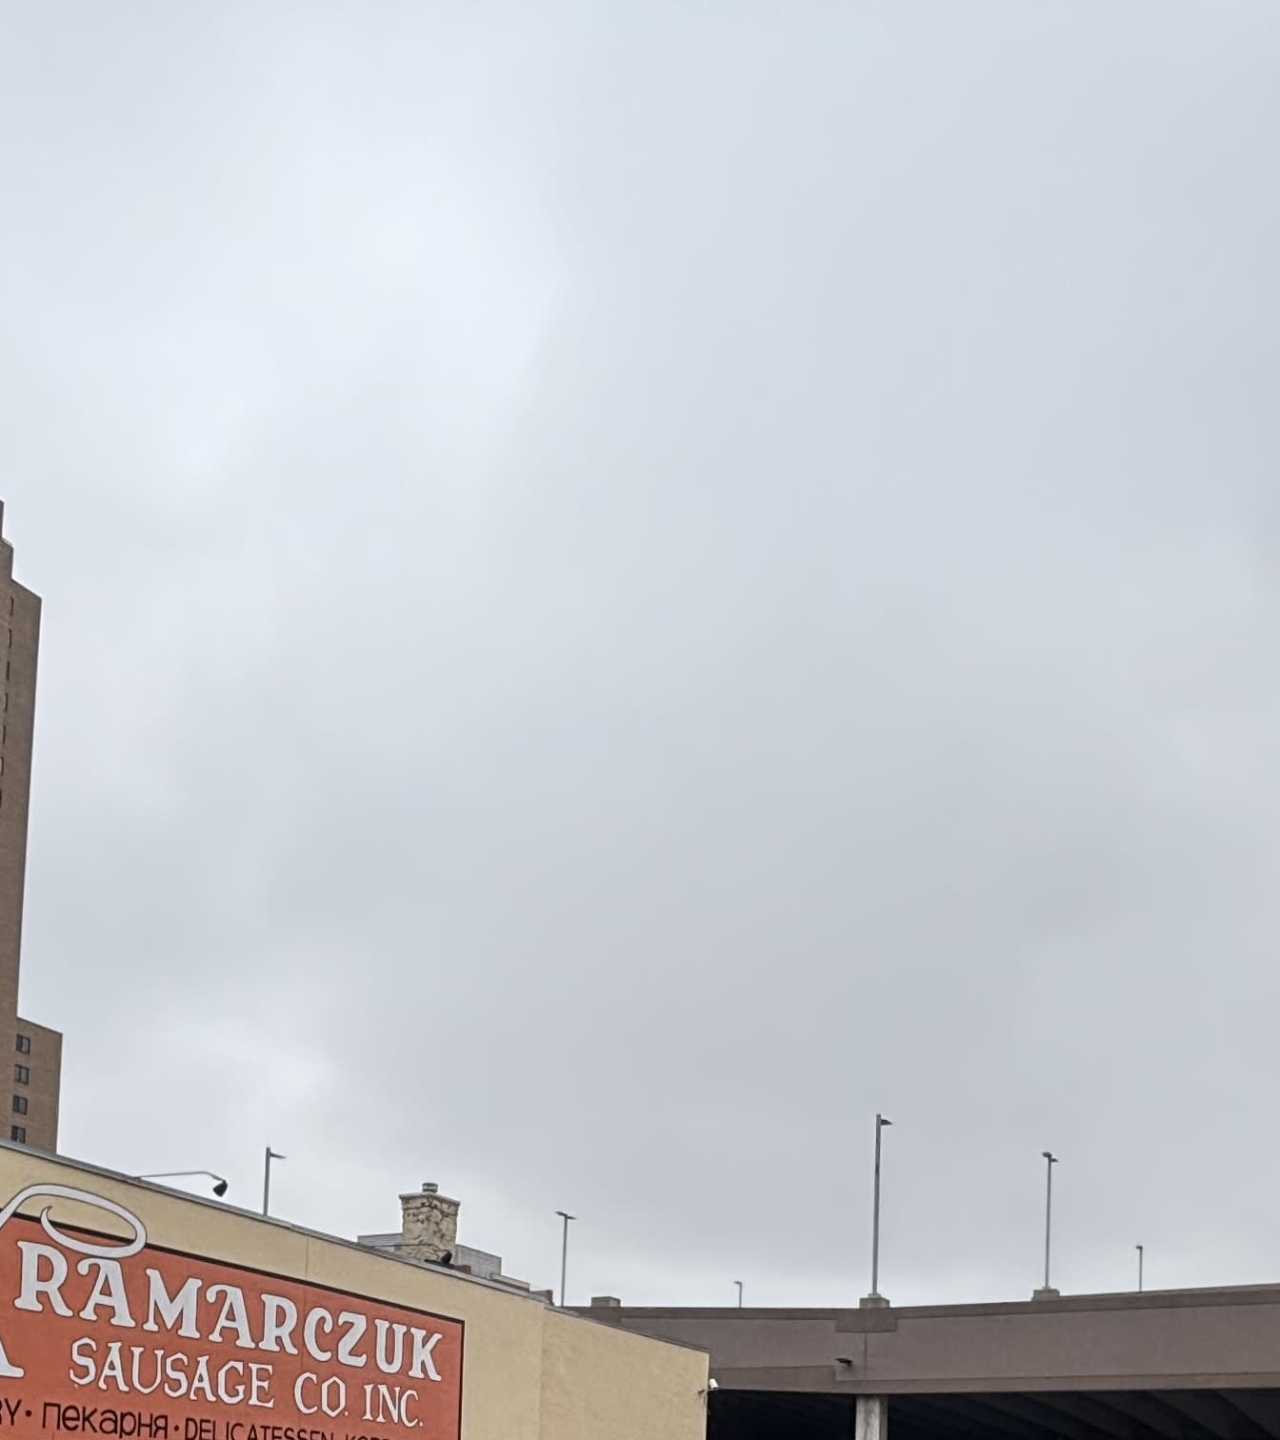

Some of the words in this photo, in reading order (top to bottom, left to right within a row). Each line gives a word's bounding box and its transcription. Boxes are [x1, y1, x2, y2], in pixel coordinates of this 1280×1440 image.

[69, 1336, 276, 1410] SAUSAGE
[294, 1371, 349, 1418] CO.
[362, 1383, 424, 1428] INC.
